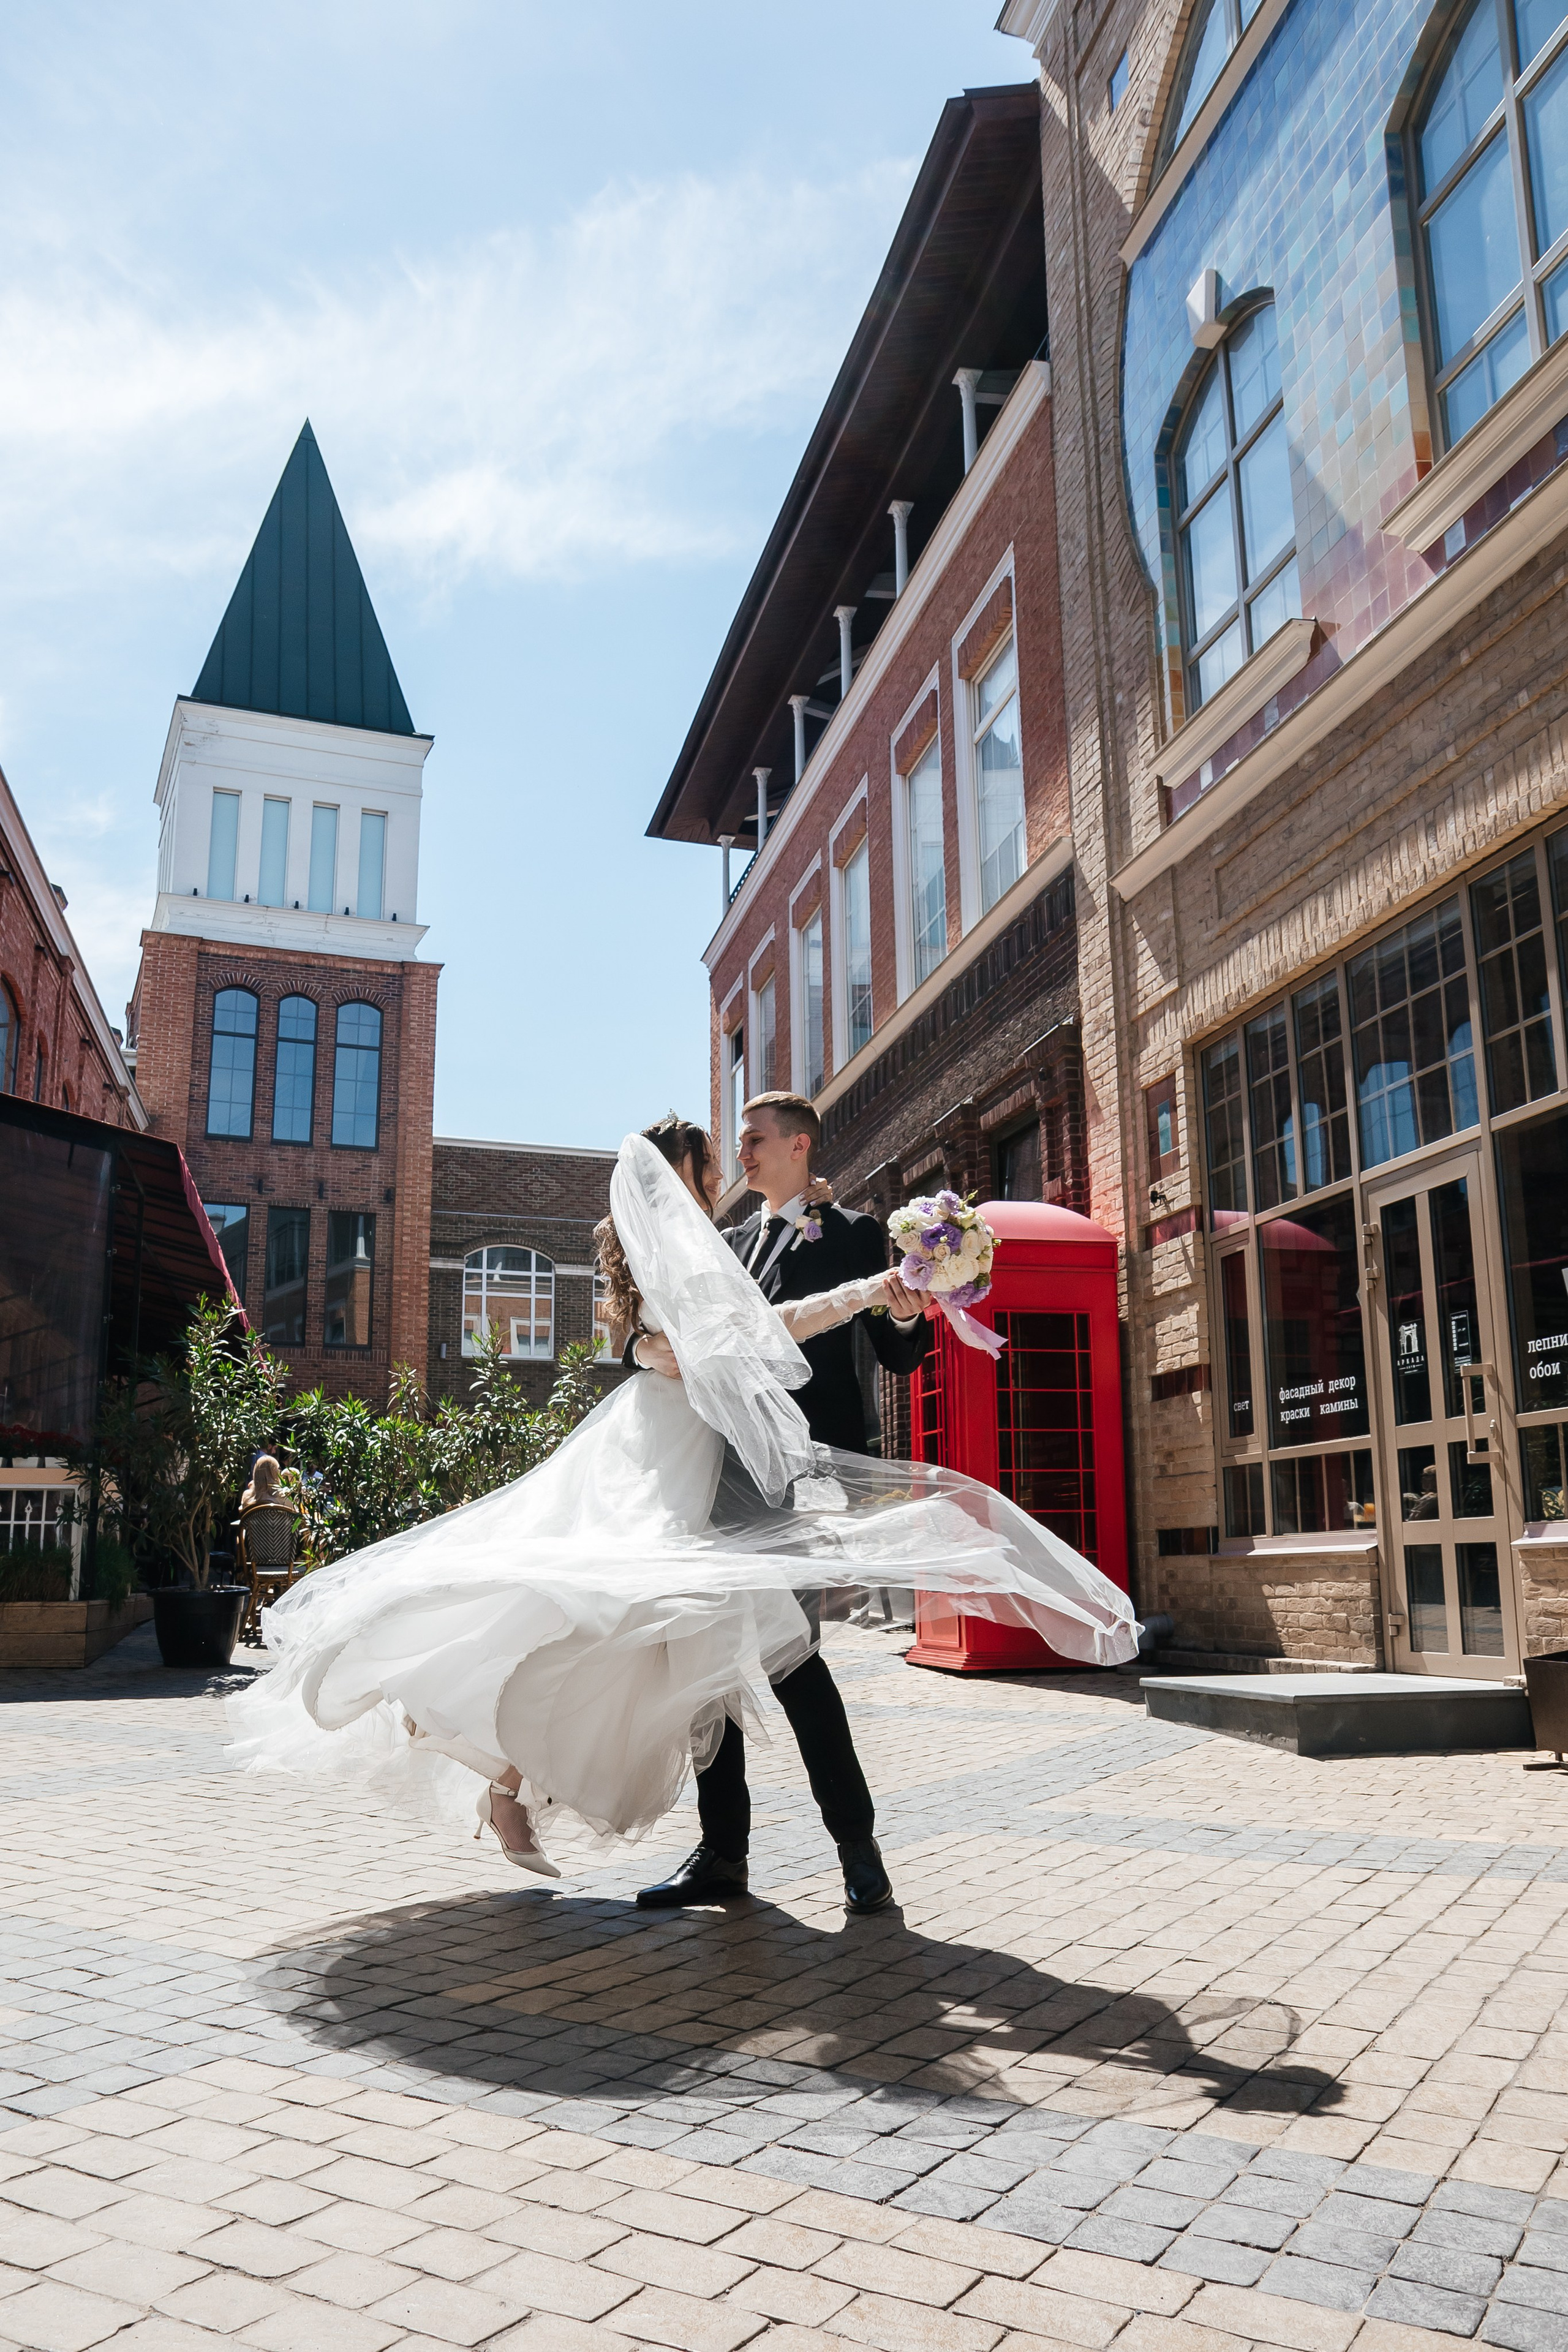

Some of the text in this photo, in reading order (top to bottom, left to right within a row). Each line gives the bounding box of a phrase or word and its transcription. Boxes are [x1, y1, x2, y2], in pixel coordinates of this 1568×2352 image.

[1529, 1360, 1561, 1379] обои
[1279, 1376, 1356, 1404] фасадный декор
[1234, 1400, 1250, 1412] свет
[1280, 1398, 1359, 1424] краски камины
